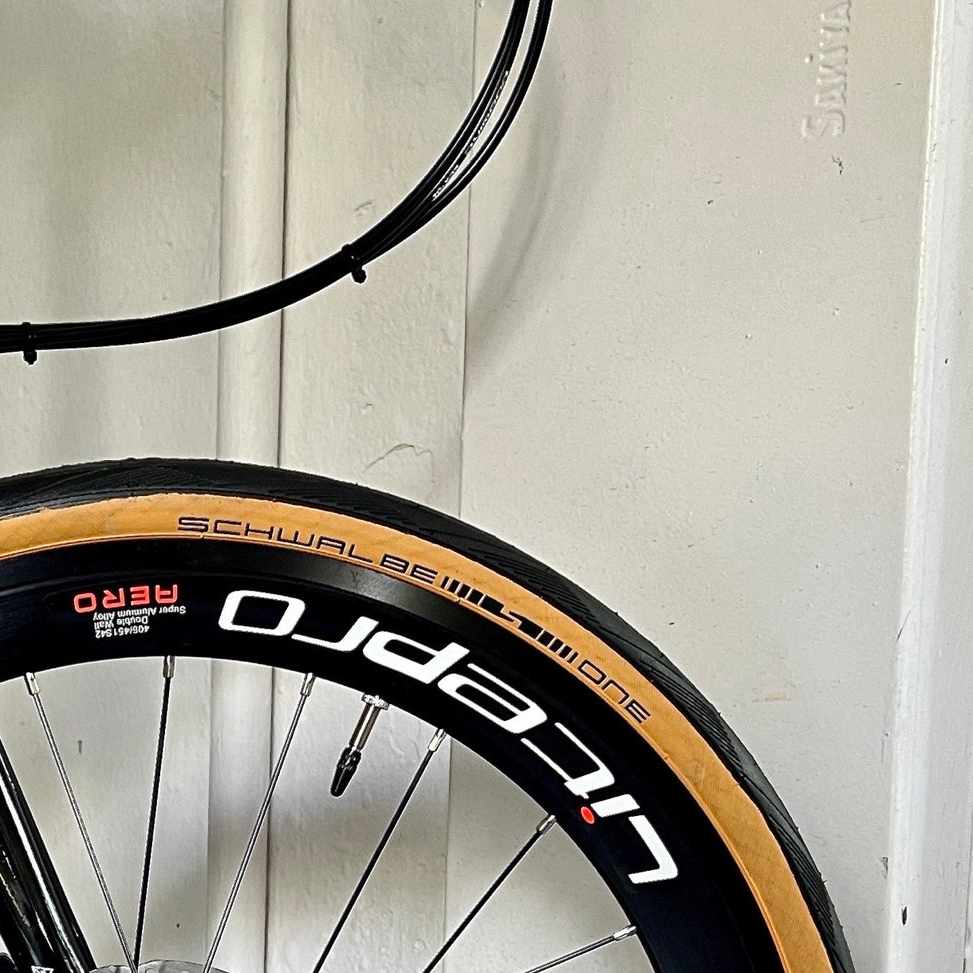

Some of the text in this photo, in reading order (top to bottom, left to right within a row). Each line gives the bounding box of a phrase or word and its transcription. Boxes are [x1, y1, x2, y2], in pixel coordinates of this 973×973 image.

[73, 584, 178, 613] AERO
[93, 611, 115, 621] Alloy
[158, 605, 187, 615] Super
[94, 615, 149, 631] Double Wall
[177, 516, 652, 725] SCHWALBE ONE
